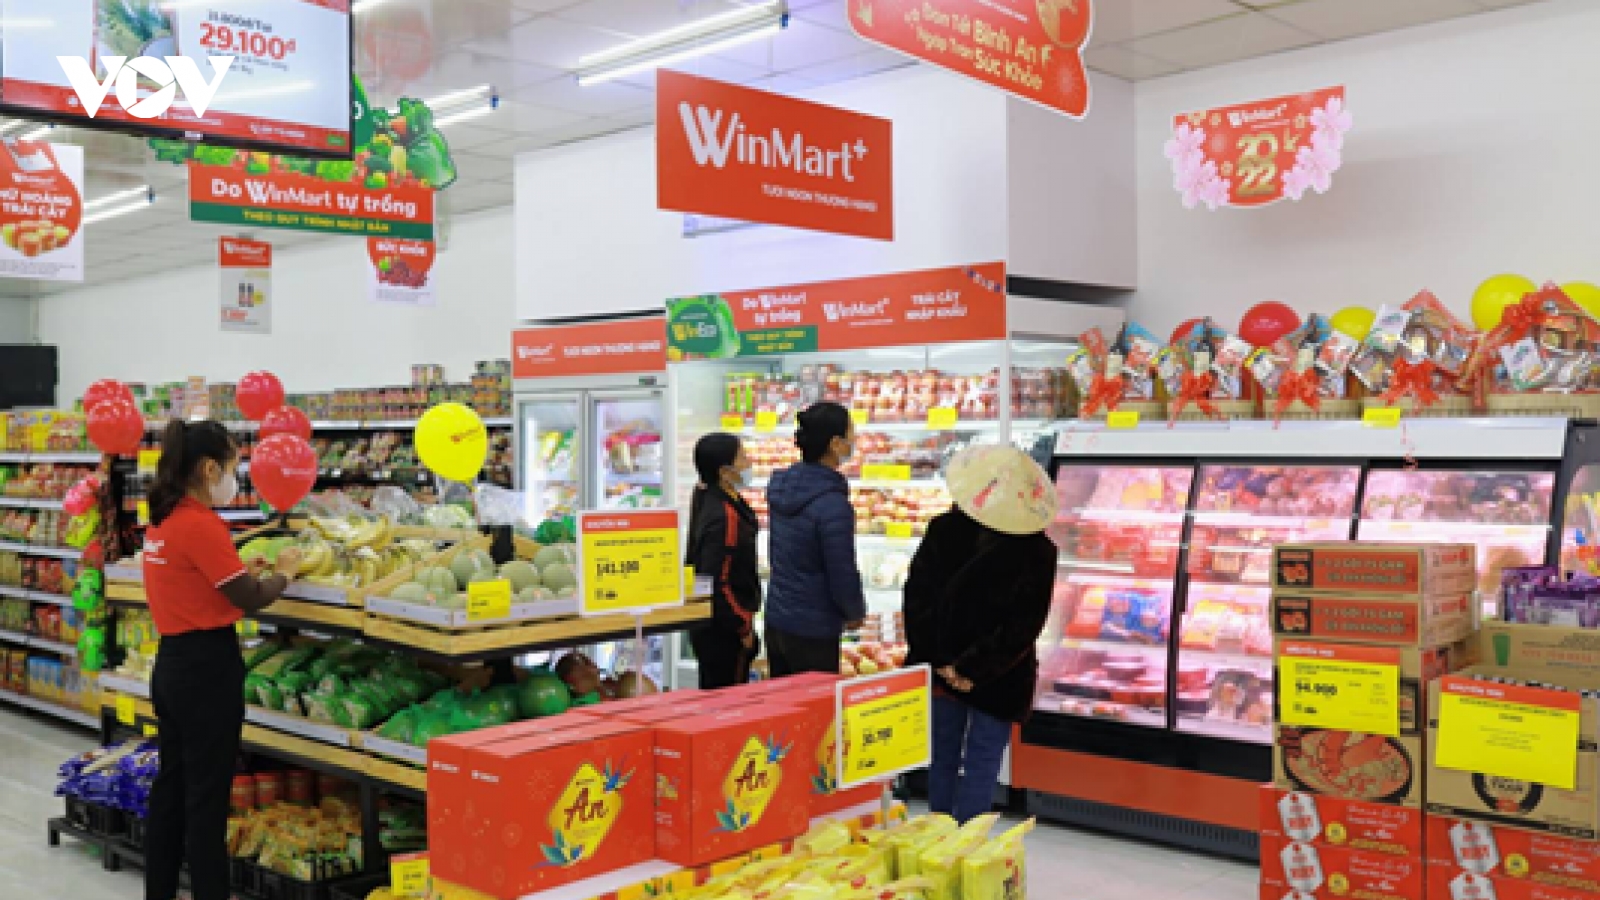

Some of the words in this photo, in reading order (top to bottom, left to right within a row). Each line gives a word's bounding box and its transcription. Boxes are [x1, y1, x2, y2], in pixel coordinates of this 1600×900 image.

[1015, 37, 1037, 64] An
[211, 178, 242, 197] Do
[244, 180, 331, 208] WinMart
[337, 191, 358, 213] tự
[364, 193, 416, 219] trồng
[734, 758, 771, 799] An
[563, 787, 608, 831] An
